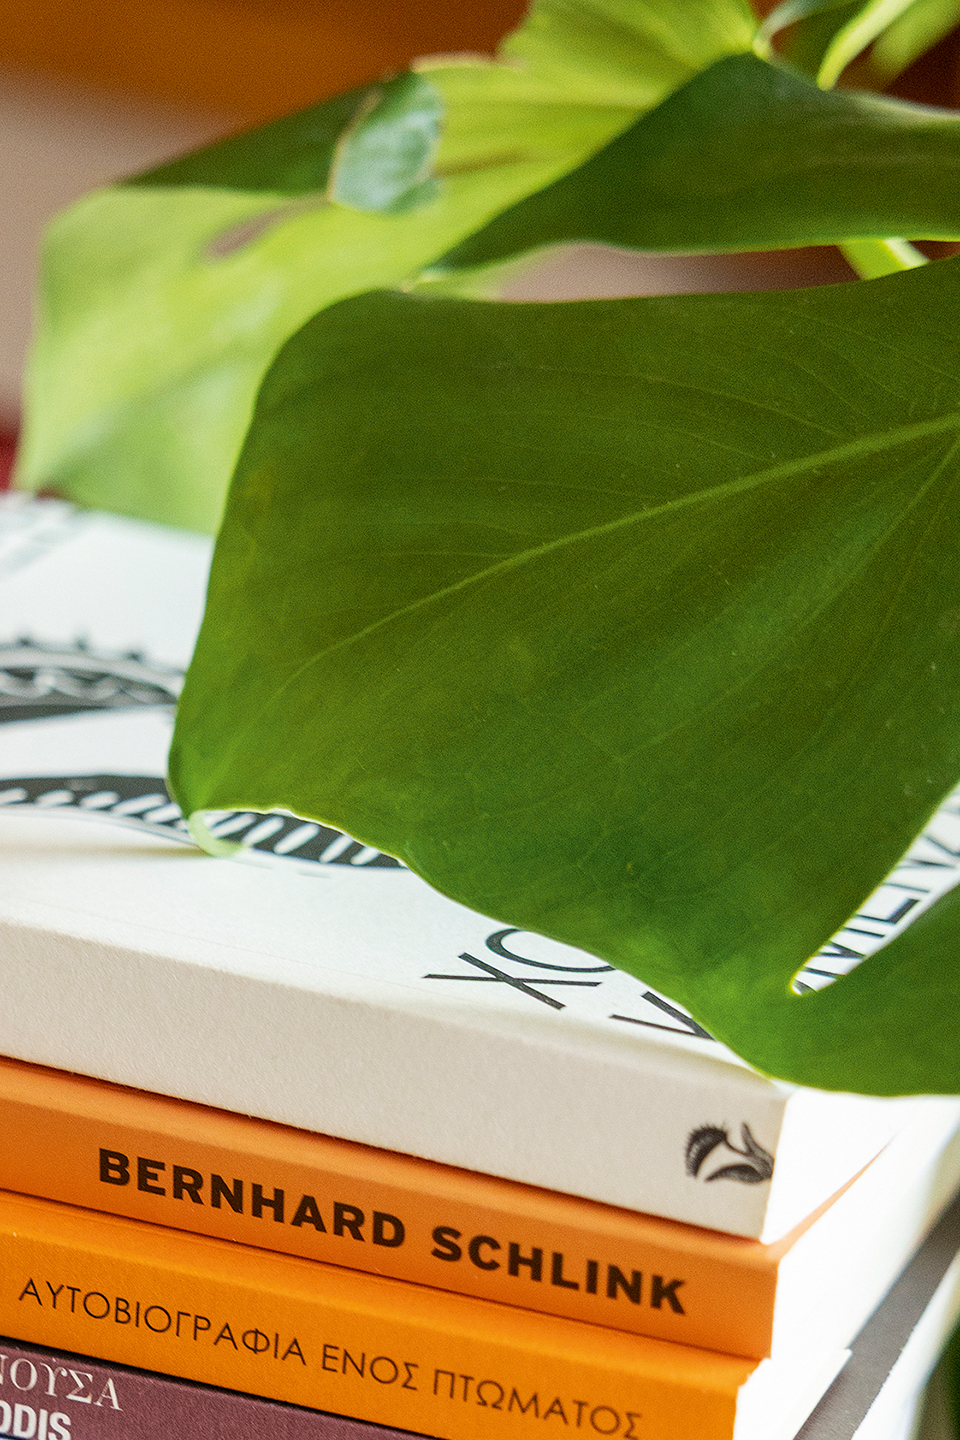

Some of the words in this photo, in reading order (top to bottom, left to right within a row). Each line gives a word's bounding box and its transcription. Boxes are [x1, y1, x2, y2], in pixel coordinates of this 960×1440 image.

[98, 1148, 406, 1248] BERNHARD
[430, 1226, 687, 1315] SCHLINK
[19, 1277, 306, 1367] ΑΥΤΟΒΙΟΓΡΑΦΙΑ
[322, 1343, 421, 1392] ΕΝΟΣ
